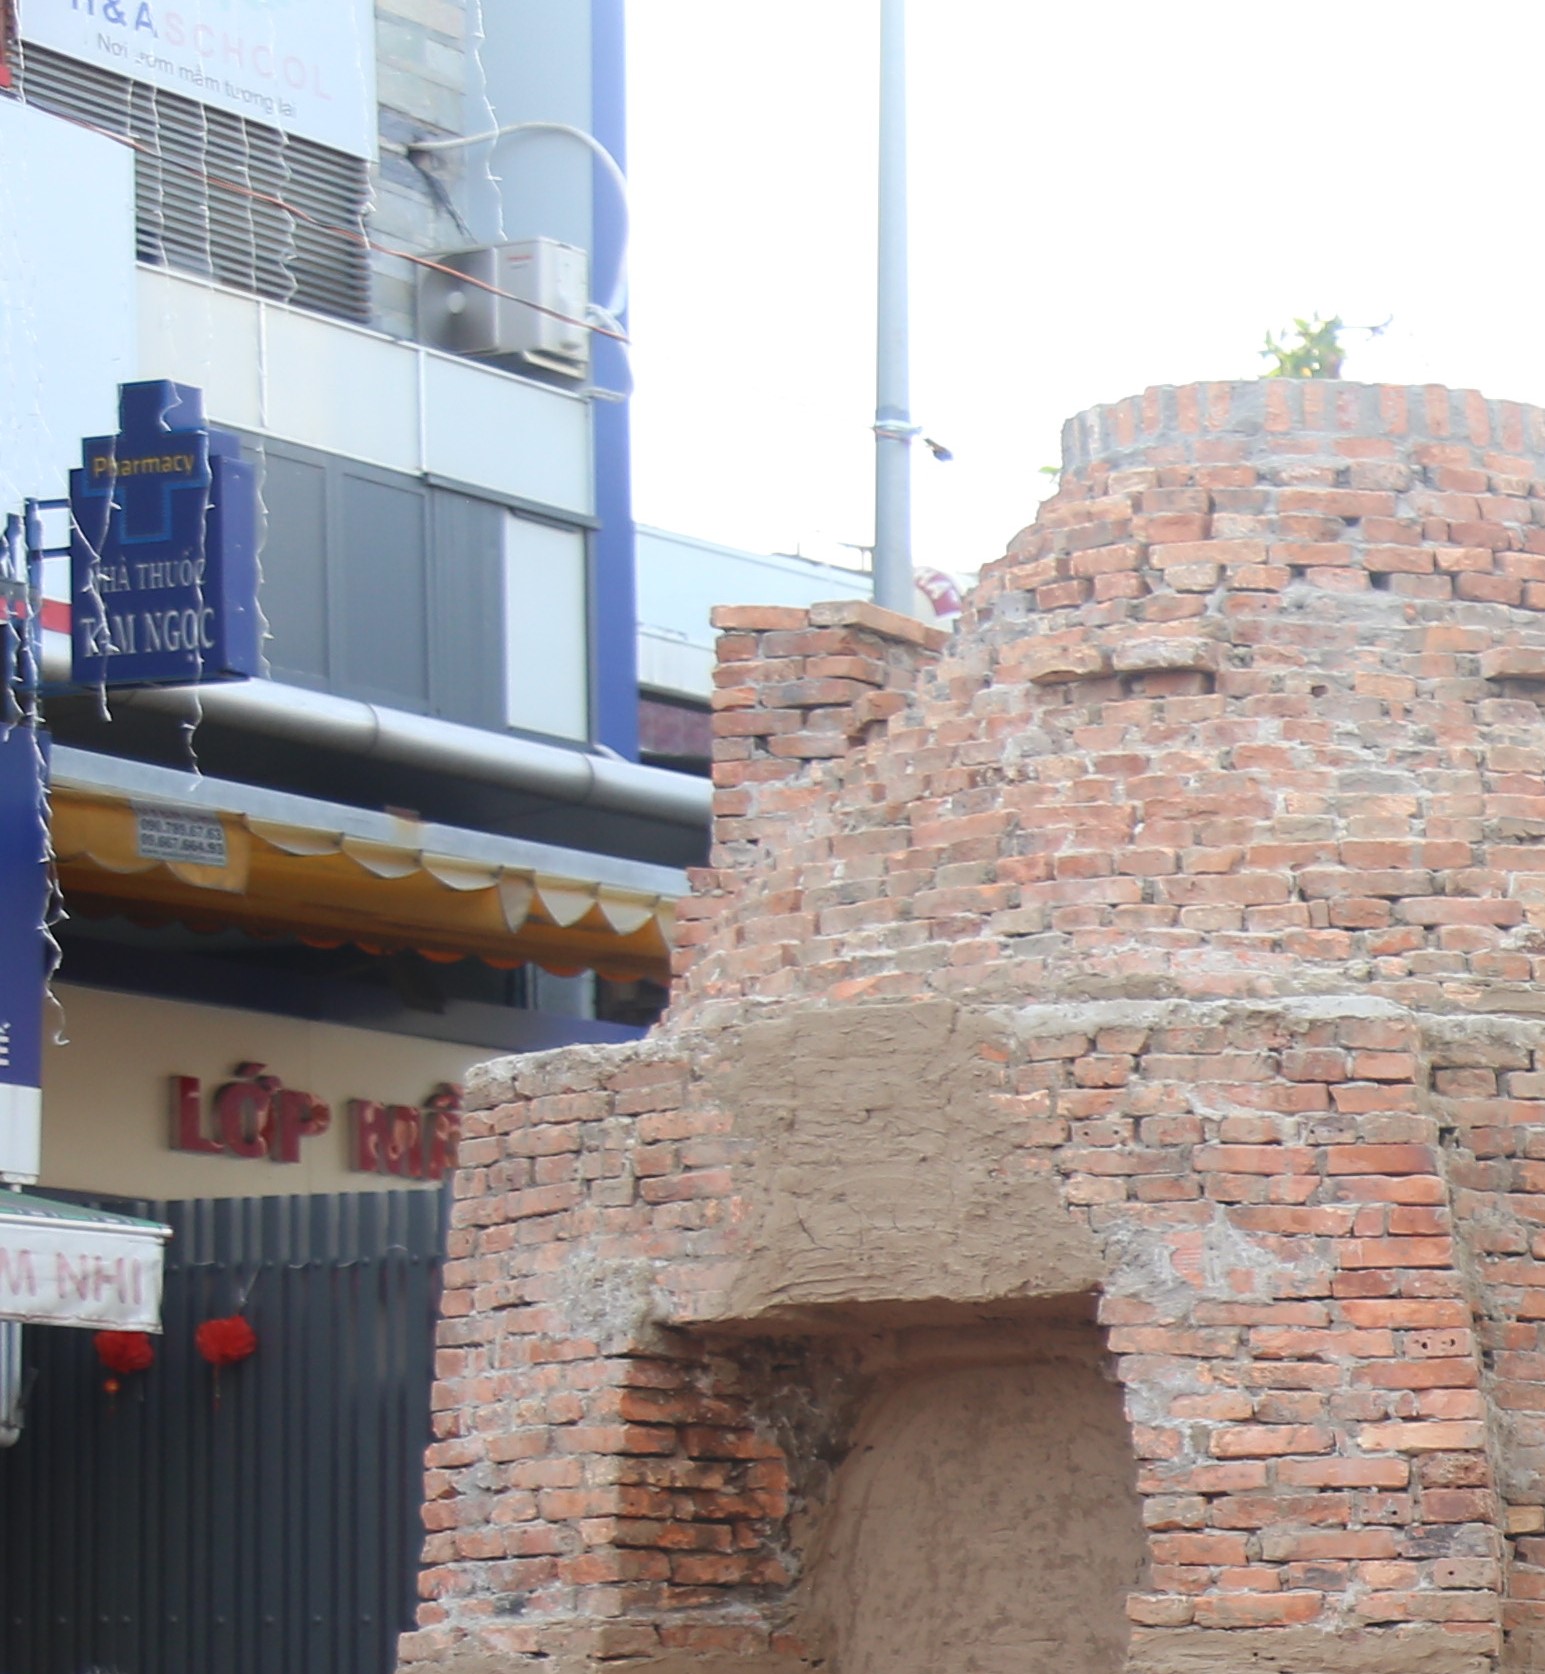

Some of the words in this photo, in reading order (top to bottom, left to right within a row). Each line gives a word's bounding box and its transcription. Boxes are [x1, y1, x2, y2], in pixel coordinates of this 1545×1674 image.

[97, 31, 129, 59] Nơi
[92, 453, 195, 478] Pharmacy
[144, 607, 216, 662] NGỌC
[168, 1061, 332, 1165] LỚP
[56, 1251, 143, 1305] NHI
